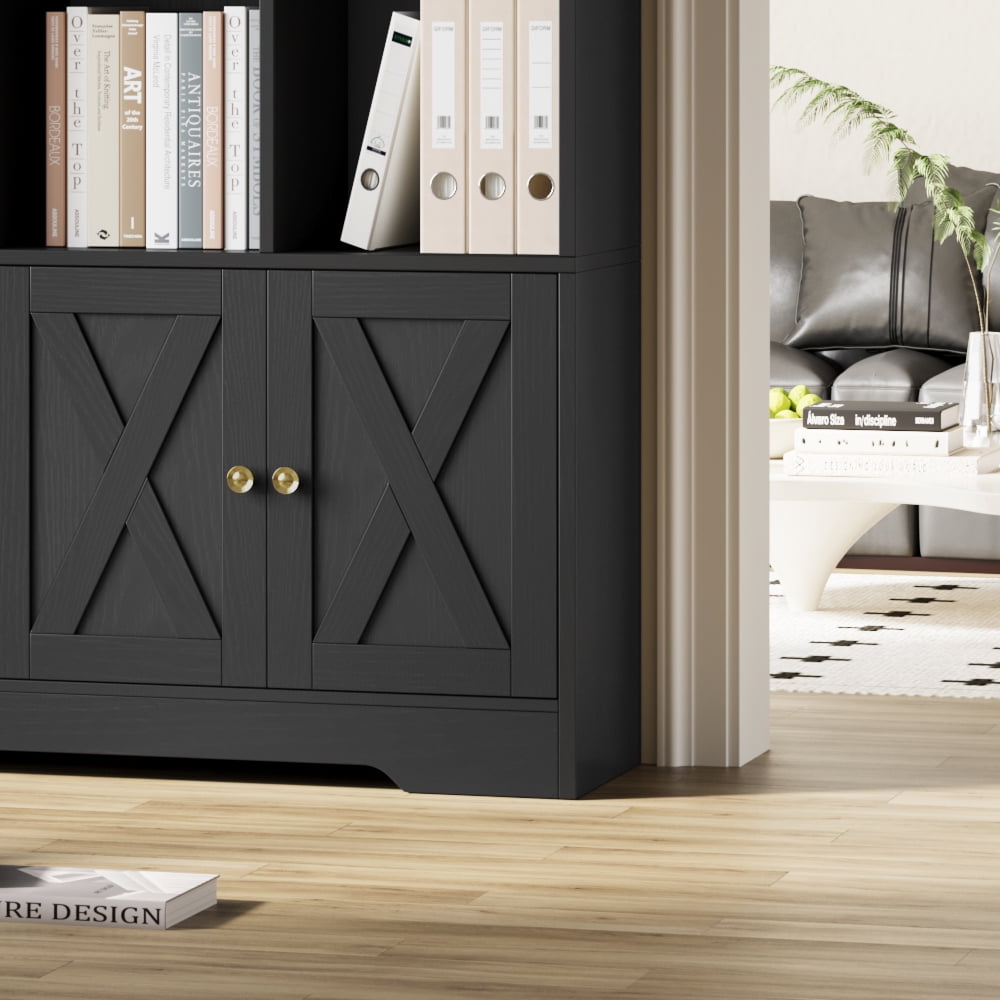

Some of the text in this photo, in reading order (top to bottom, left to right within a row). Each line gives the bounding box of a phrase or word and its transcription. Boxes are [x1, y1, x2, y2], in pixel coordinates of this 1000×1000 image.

[103, 48, 111, 63] The
[163, 34, 172, 54] Detail
[103, 64, 111, 74] Art
[123, 66, 142, 105] ART
[162, 63, 172, 109] Contemporary
[102, 83, 111, 110] Knitting
[49, 105, 61, 166] BORDEAUX
[163, 111, 172, 149] Residential
[186, 72, 201, 188] ANTIQUAIRES
[206, 106, 218, 167] BORDEAUX
[163, 150, 172, 190] Architecture
[52, 903, 162, 926] DESIGN
